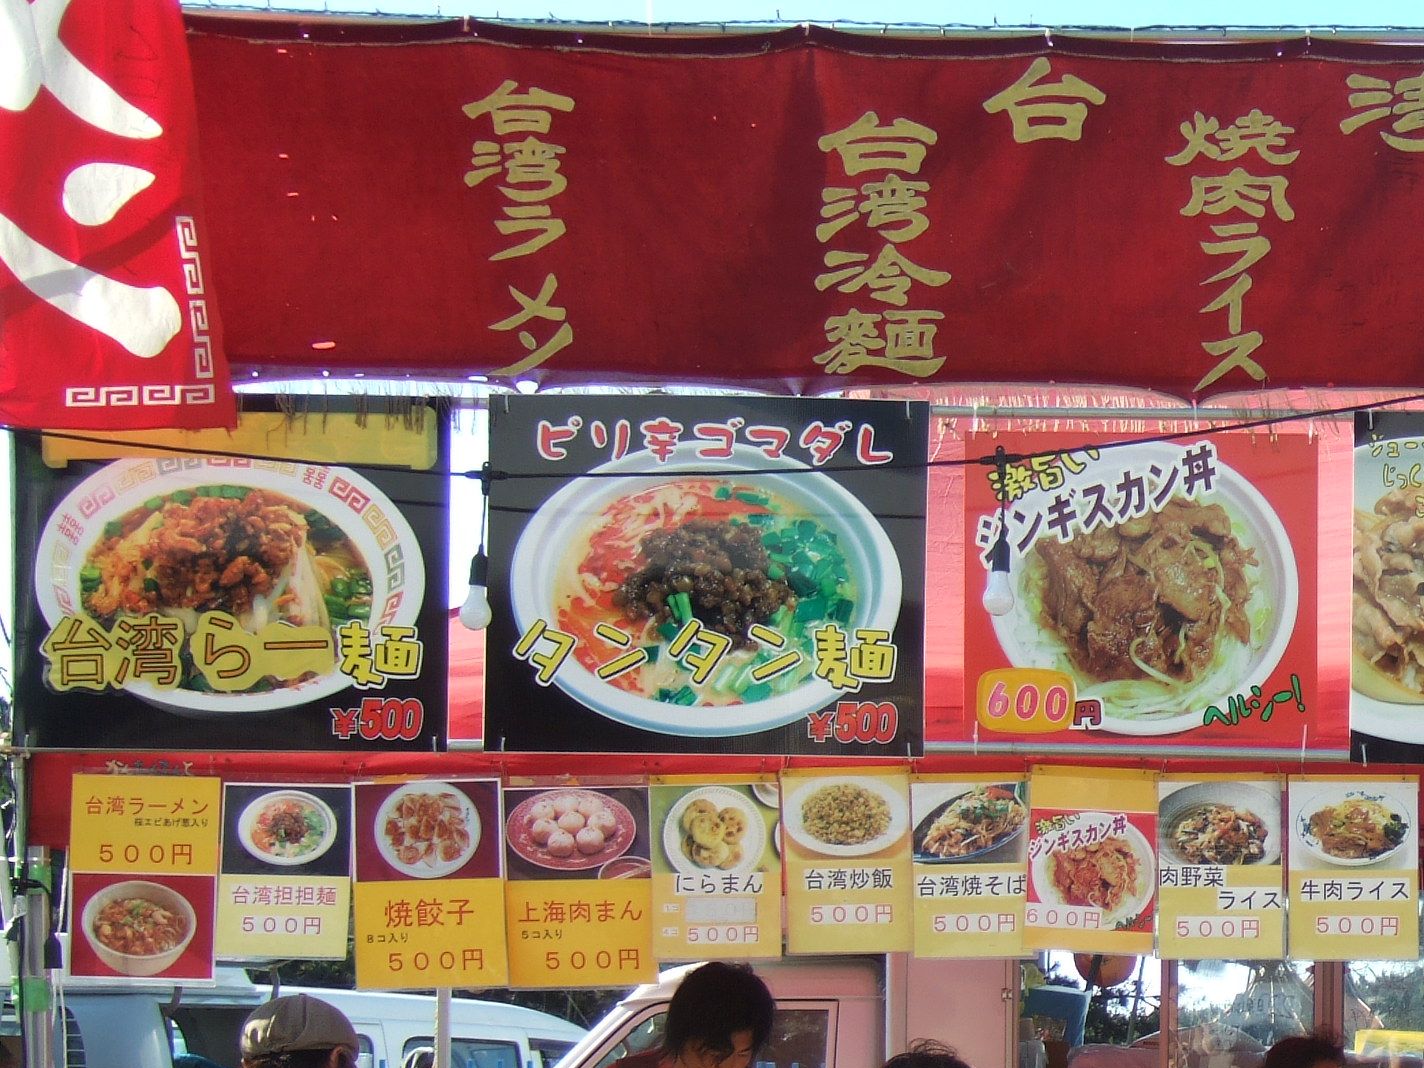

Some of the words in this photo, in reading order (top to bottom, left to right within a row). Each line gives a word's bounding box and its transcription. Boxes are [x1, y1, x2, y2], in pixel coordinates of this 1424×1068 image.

[537, 416, 894, 465] ピリ辛ゴマダレ
[48, 613, 422, 691] 台湾らー麺
[513, 617, 898, 694] タンタン麺
[986, 681, 1102, 728] 600円
[332, 698, 424, 741] ¥500
[807, 700, 899, 745] ¥500
[85, 796, 209, 816] 台湾ラーメン
[100, 844, 193, 865] 500円
[676, 874, 764, 894] にらまん
[805, 869, 893, 890] 台湾炒飯
[1160, 867, 1224, 888] 肉野菜
[232, 886, 337, 906] 台湾担担麺
[1218, 890, 1282, 910] ライス
[1301, 879, 1409, 901] 牛肉ライス
[384, 899, 475, 927] 焼餃子
[518, 900, 643, 924] 上海肉まん
[810, 905, 893, 923] 500円
[1026, 908, 1101, 929] 600円
[242, 917, 322, 935] 500円
[688, 926, 759, 942] 500円
[934, 914, 1016, 933] 500円
[1177, 919, 1260, 938] 500円
[1316, 917, 1399, 936] 500円
[388, 948, 483, 971] 500円
[546, 948, 640, 970] 500円
